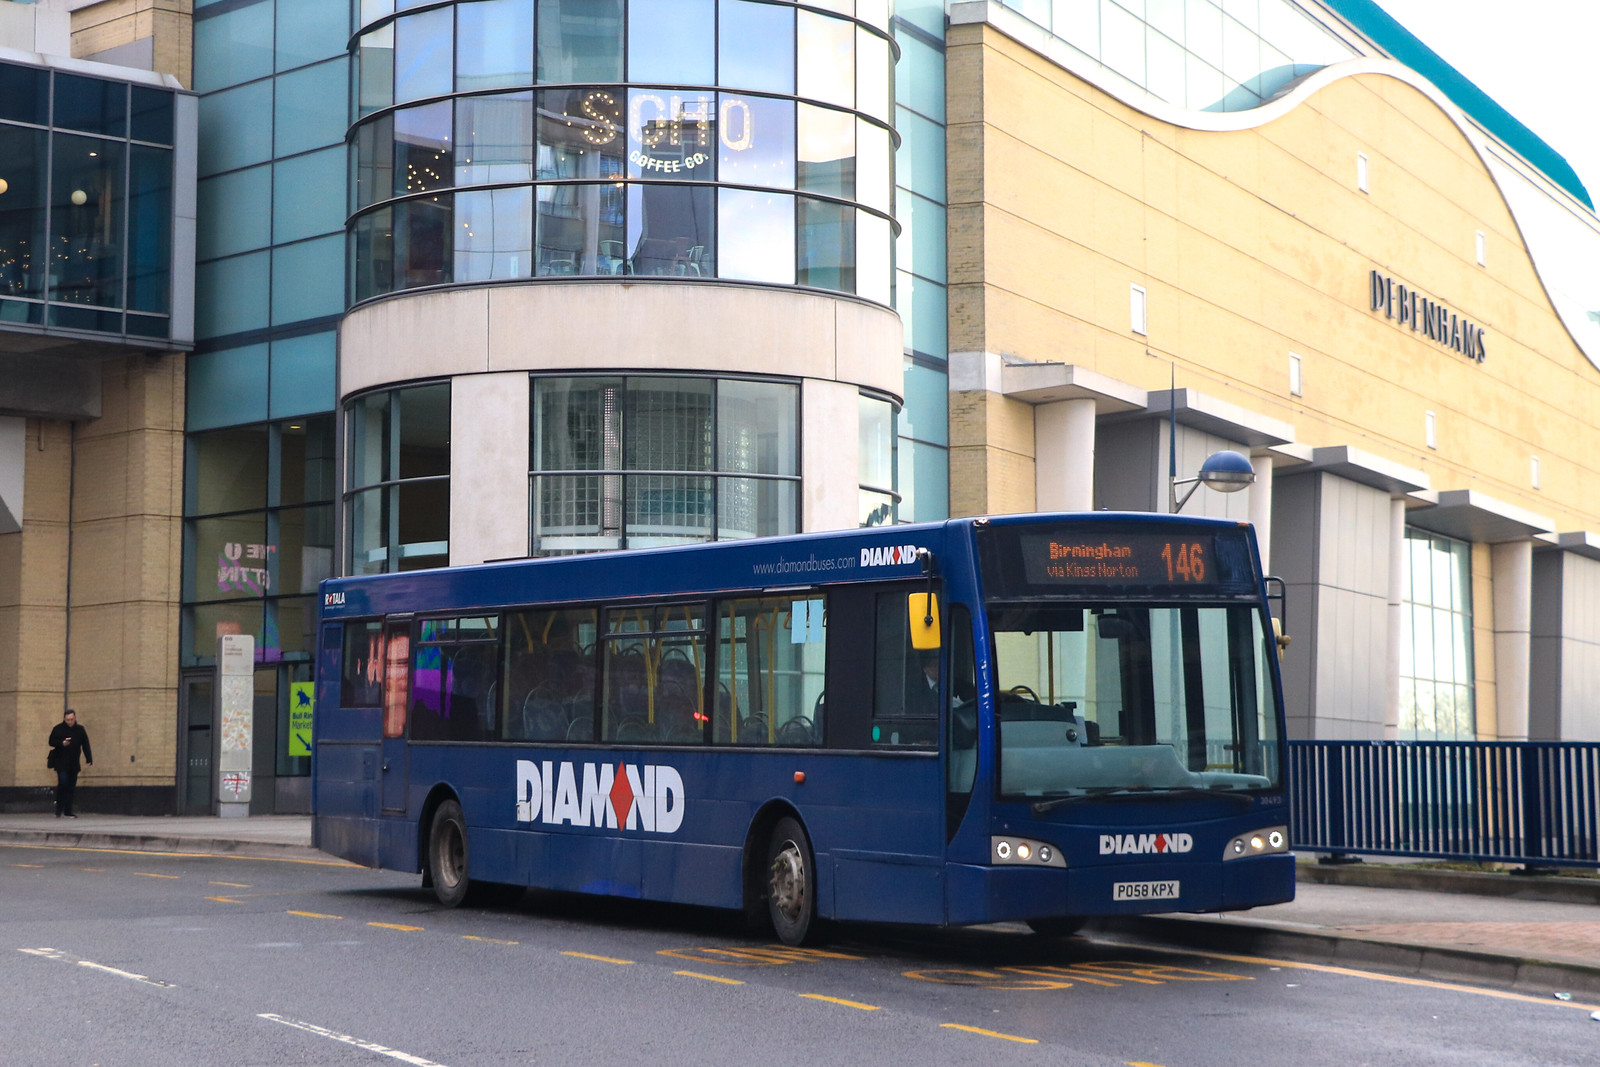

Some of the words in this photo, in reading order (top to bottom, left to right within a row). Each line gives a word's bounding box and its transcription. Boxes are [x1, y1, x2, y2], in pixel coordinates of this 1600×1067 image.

[629, 150, 681, 173] COFFEE
[1369, 270, 1486, 364] DEBENHAMS
[753, 553, 856, 575] www.diamondbuses.com
[1047, 562, 1065, 577] via
[1067, 562, 1096, 577] Kings
[1098, 562, 1139, 578] Norton
[1049, 541, 1132, 560] Birmingham
[1161, 543, 1205, 582] 146
[292, 720, 313, 730] Market
[293, 712, 303, 720] Bull
[304, 712, 313, 720] Rin
[1151, 883, 1175, 898] KPX
